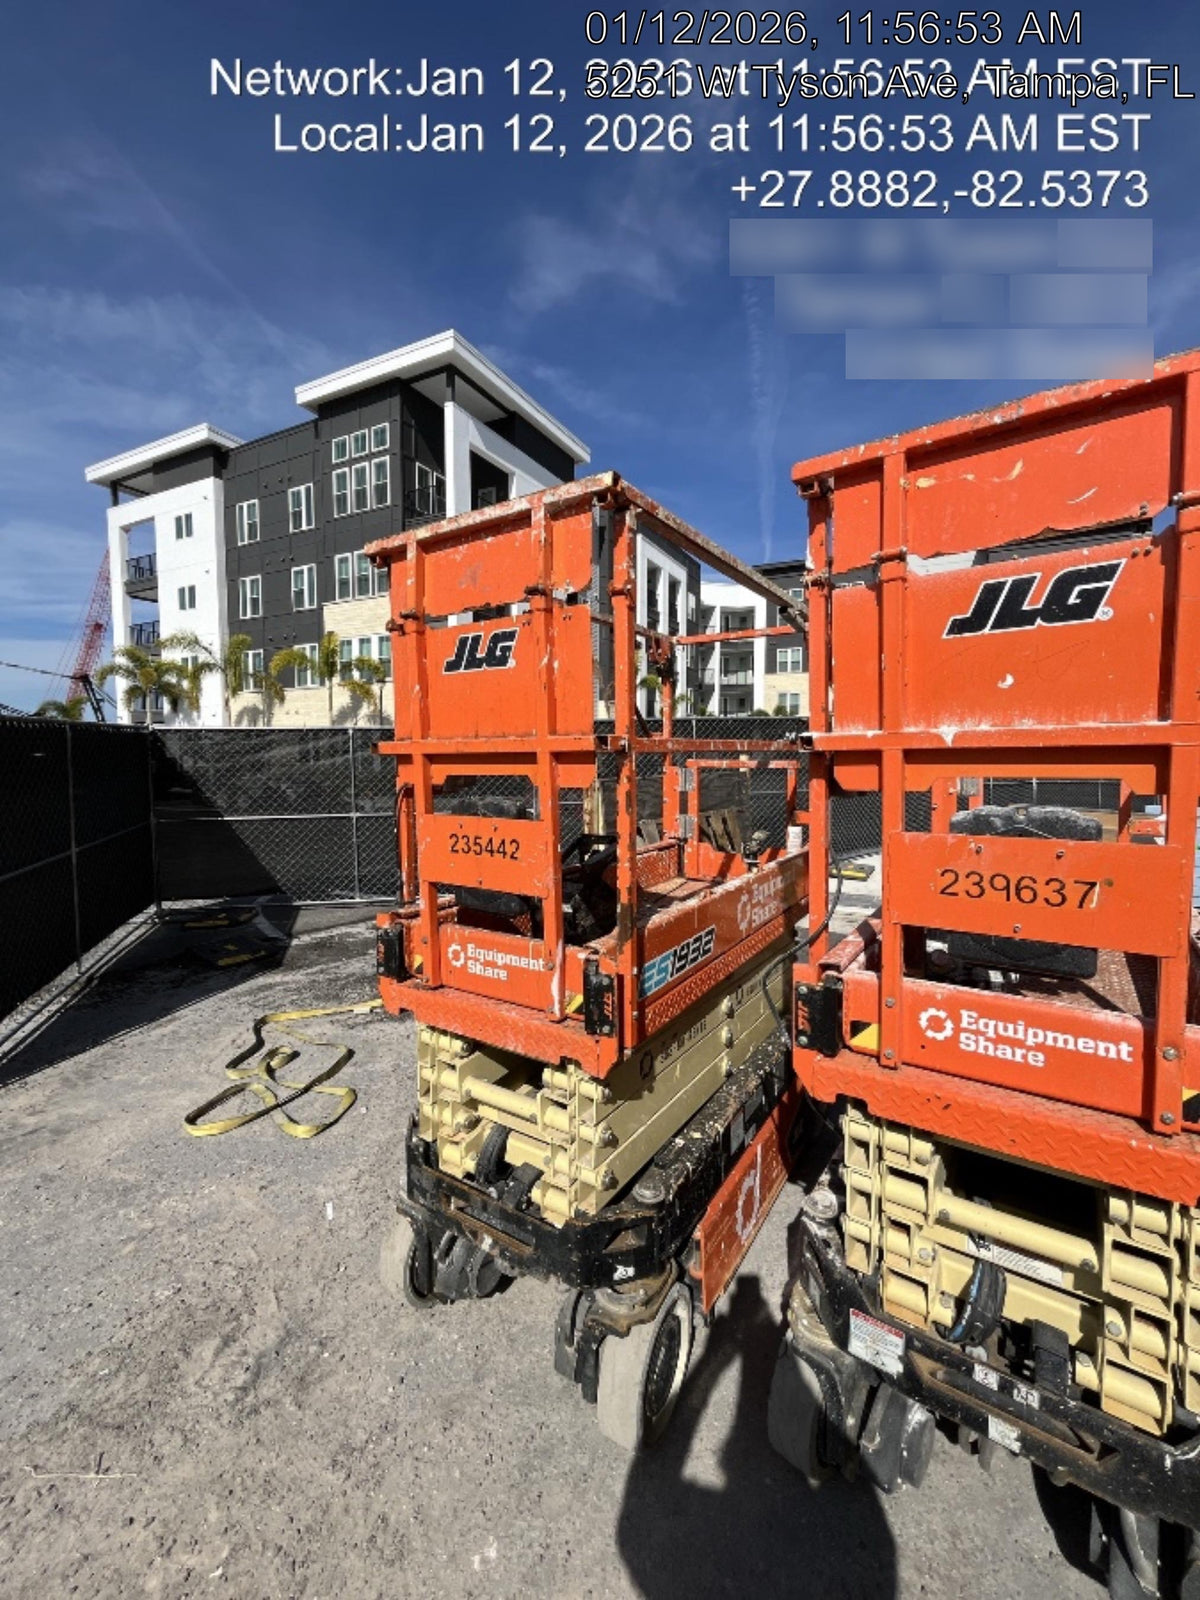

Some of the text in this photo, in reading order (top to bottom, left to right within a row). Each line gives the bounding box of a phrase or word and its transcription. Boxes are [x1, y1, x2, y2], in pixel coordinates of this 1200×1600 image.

[942, 558, 1128, 639] JLG
[442, 627, 519, 675] JLG
[449, 833, 520, 860] 235442
[939, 869, 1099, 909] 239637
[467, 943, 546, 972] Equipment
[467, 959, 508, 981] Share
[641, 925, 717, 997] ES1932
[959, 1009, 1134, 1063] Equipment
[959, 1032, 1046, 1068] Share
